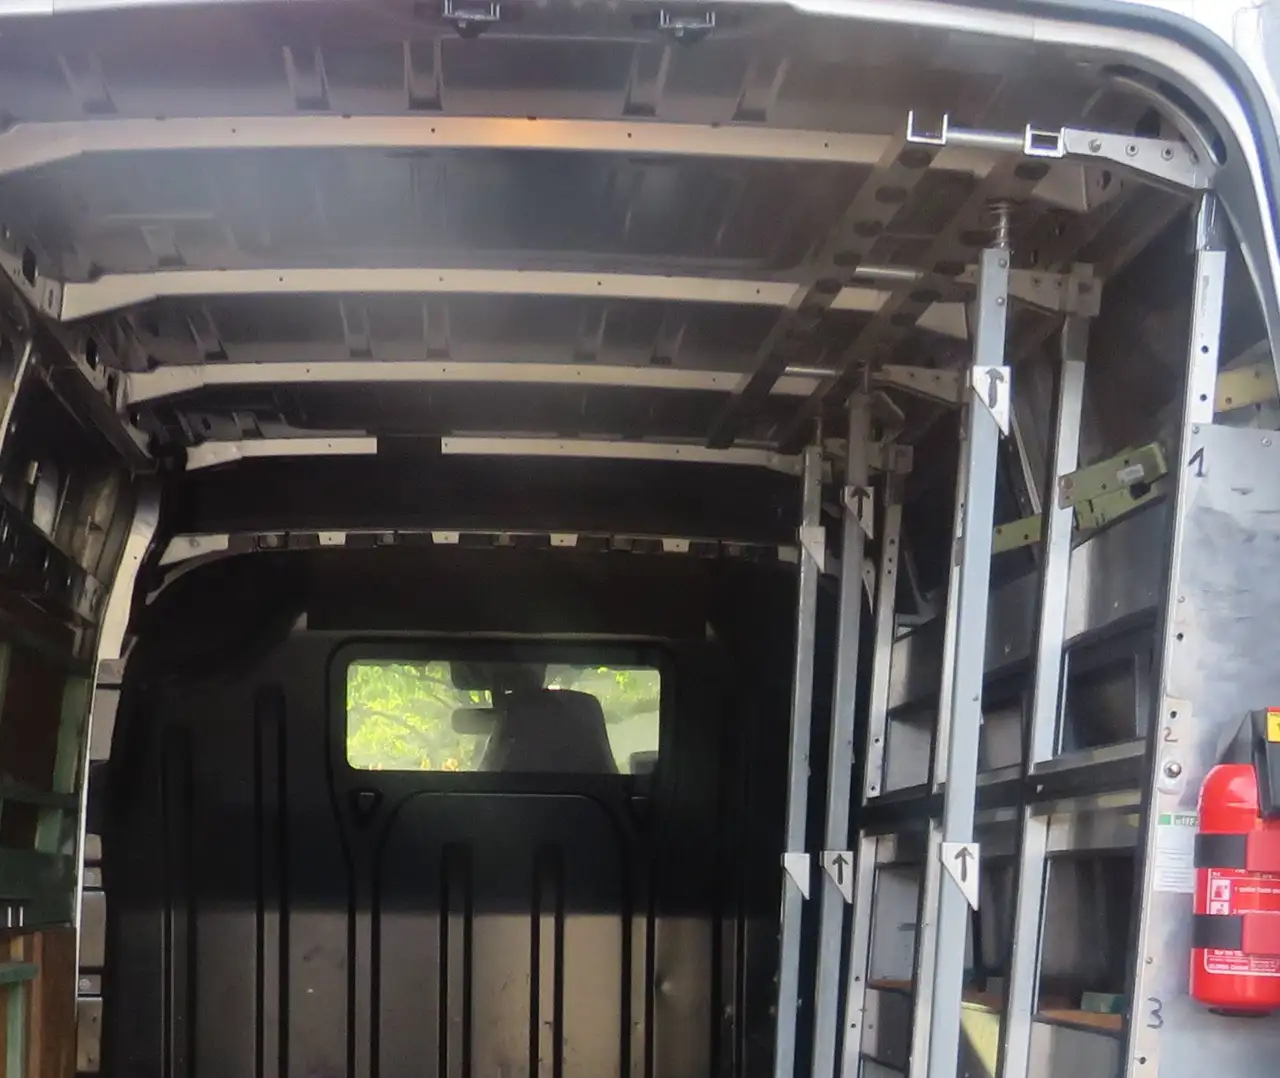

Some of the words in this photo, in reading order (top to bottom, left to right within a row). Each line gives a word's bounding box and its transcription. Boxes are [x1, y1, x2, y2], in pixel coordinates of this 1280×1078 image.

[1187, 446, 1205, 478] 1
[1163, 726, 1179, 743] 2
[1146, 996, 1164, 1030] 3
